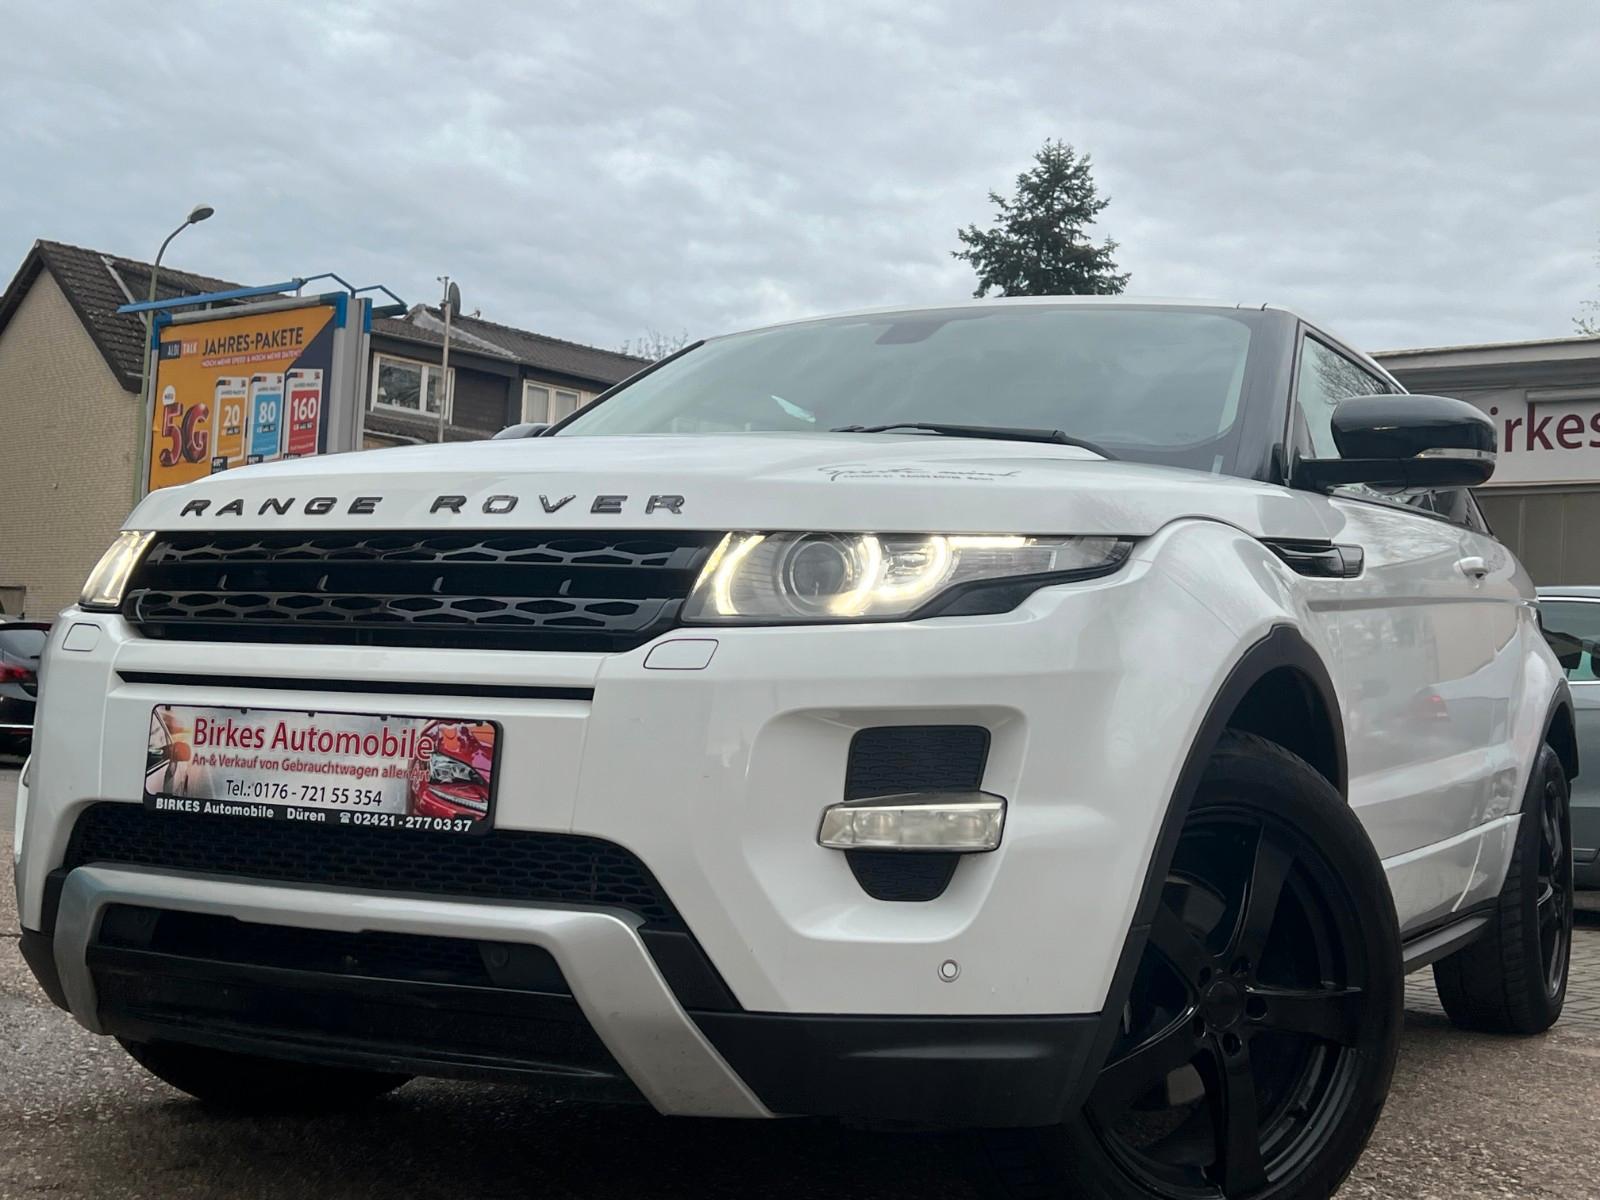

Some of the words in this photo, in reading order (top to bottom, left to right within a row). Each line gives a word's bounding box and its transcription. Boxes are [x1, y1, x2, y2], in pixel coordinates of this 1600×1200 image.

[183, 341, 198, 354] TALK
[202, 327, 304, 356] JAHRES-PAKETE
[223, 404, 240, 427] 20
[258, 401, 276, 423] 80
[293, 397, 317, 421] 160
[160, 402, 209, 467] 5G
[180, 496, 384, 517] RANGE
[428, 494, 686, 515] ROVER
[193, 718, 265, 749] Birkes
[271, 722, 433, 760] Automobile
[219, 754, 257, 768] Verkauf
[259, 760, 279, 770] von
[282, 758, 378, 779] Gebrauchtwagen
[382, 766, 408, 779] aller
[409, 768, 430, 782] Art
[226, 780, 251, 797] Tel.:
[254, 782, 288, 799] 0176
[300, 785, 325, 802] 721
[331, 788, 349, 804] 55
[353, 790, 382, 806] 354
[156, 798, 200, 812] BIRKES
[204, 802, 274, 818] Automobile
[287, 808, 326, 822] Düren
